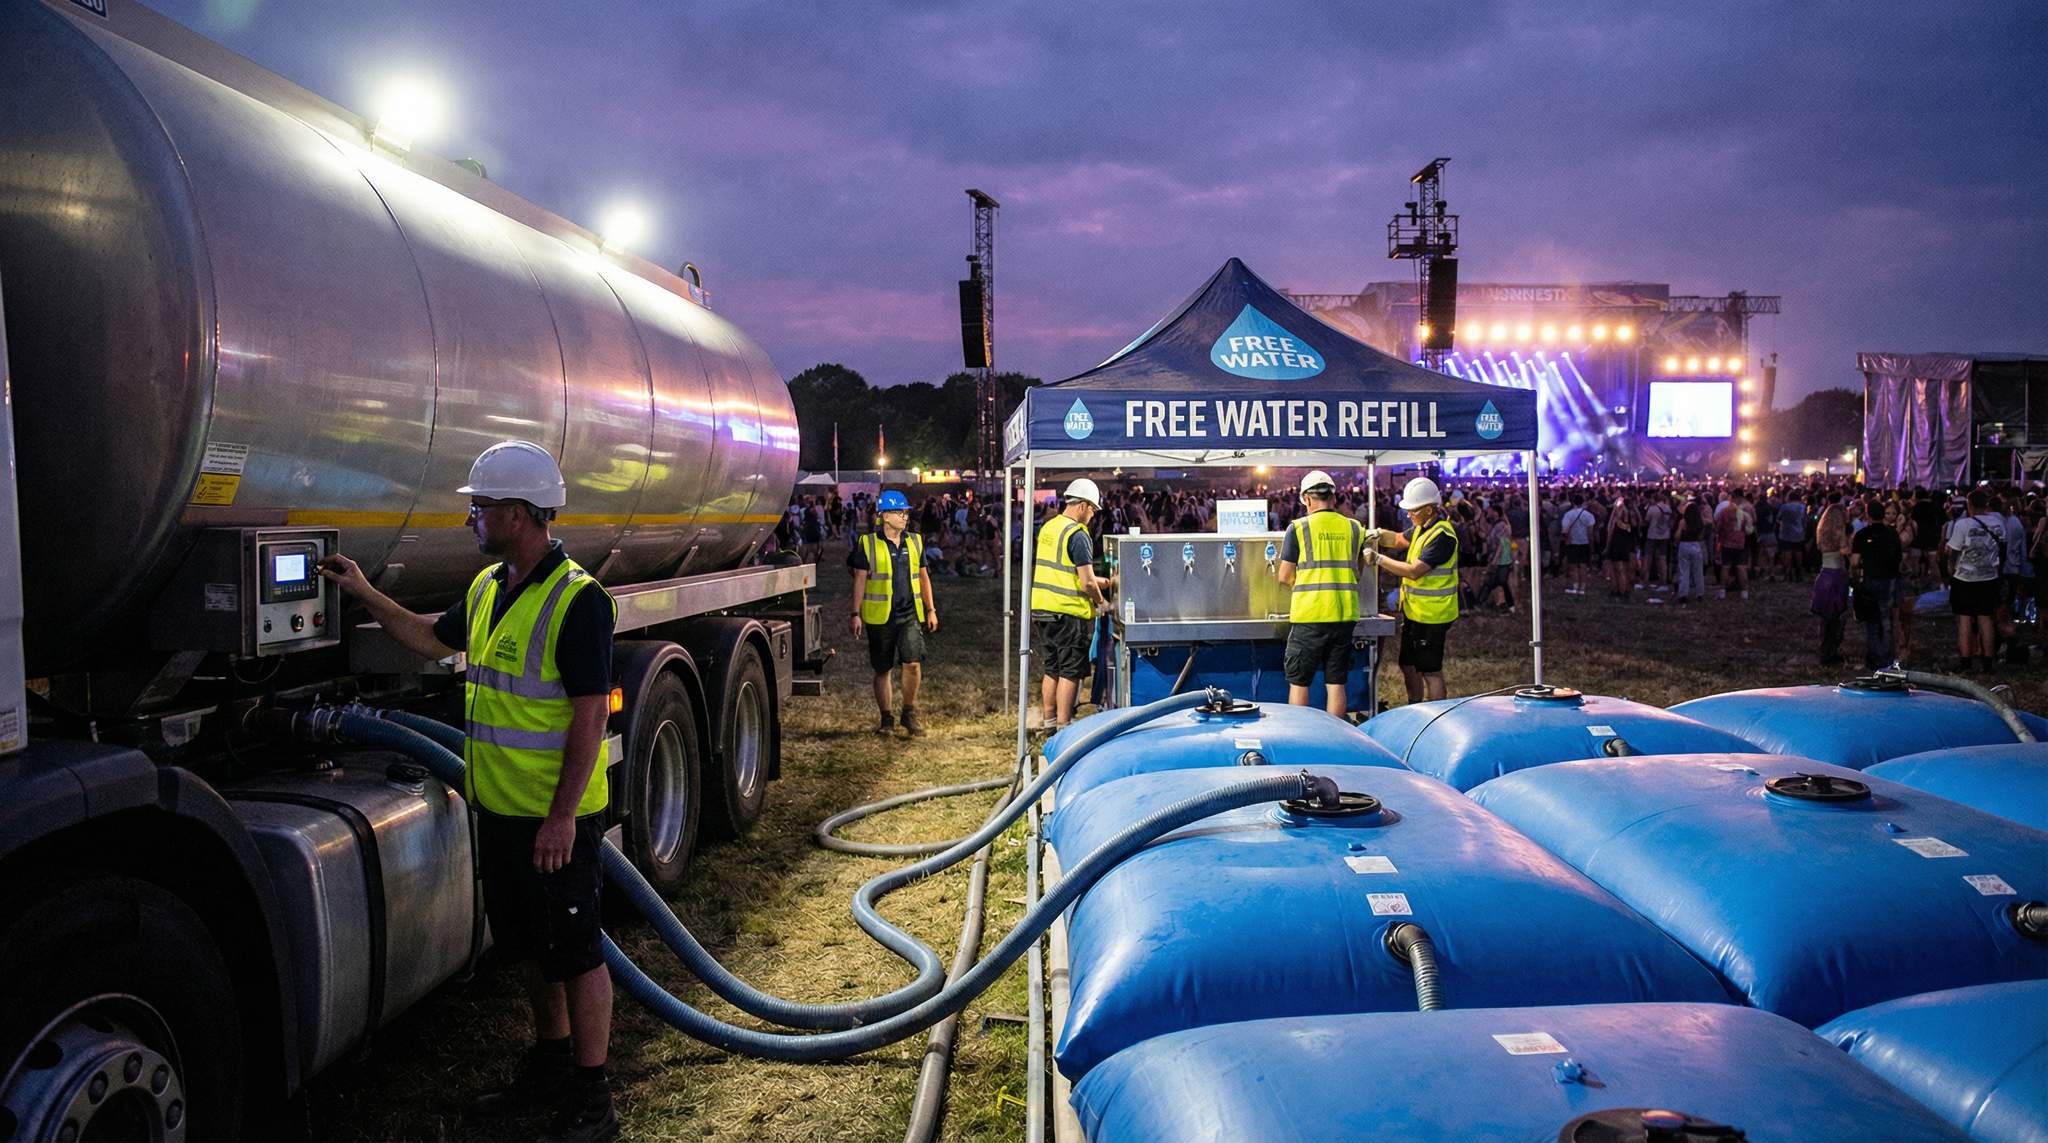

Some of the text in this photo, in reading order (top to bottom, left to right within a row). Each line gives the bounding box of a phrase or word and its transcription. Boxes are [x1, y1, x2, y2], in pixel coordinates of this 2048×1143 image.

[1229, 336, 1298, 353] FREE
[1220, 352, 1319, 369] WATER
[1126, 400, 1446, 438] FREE WATER REFILL
